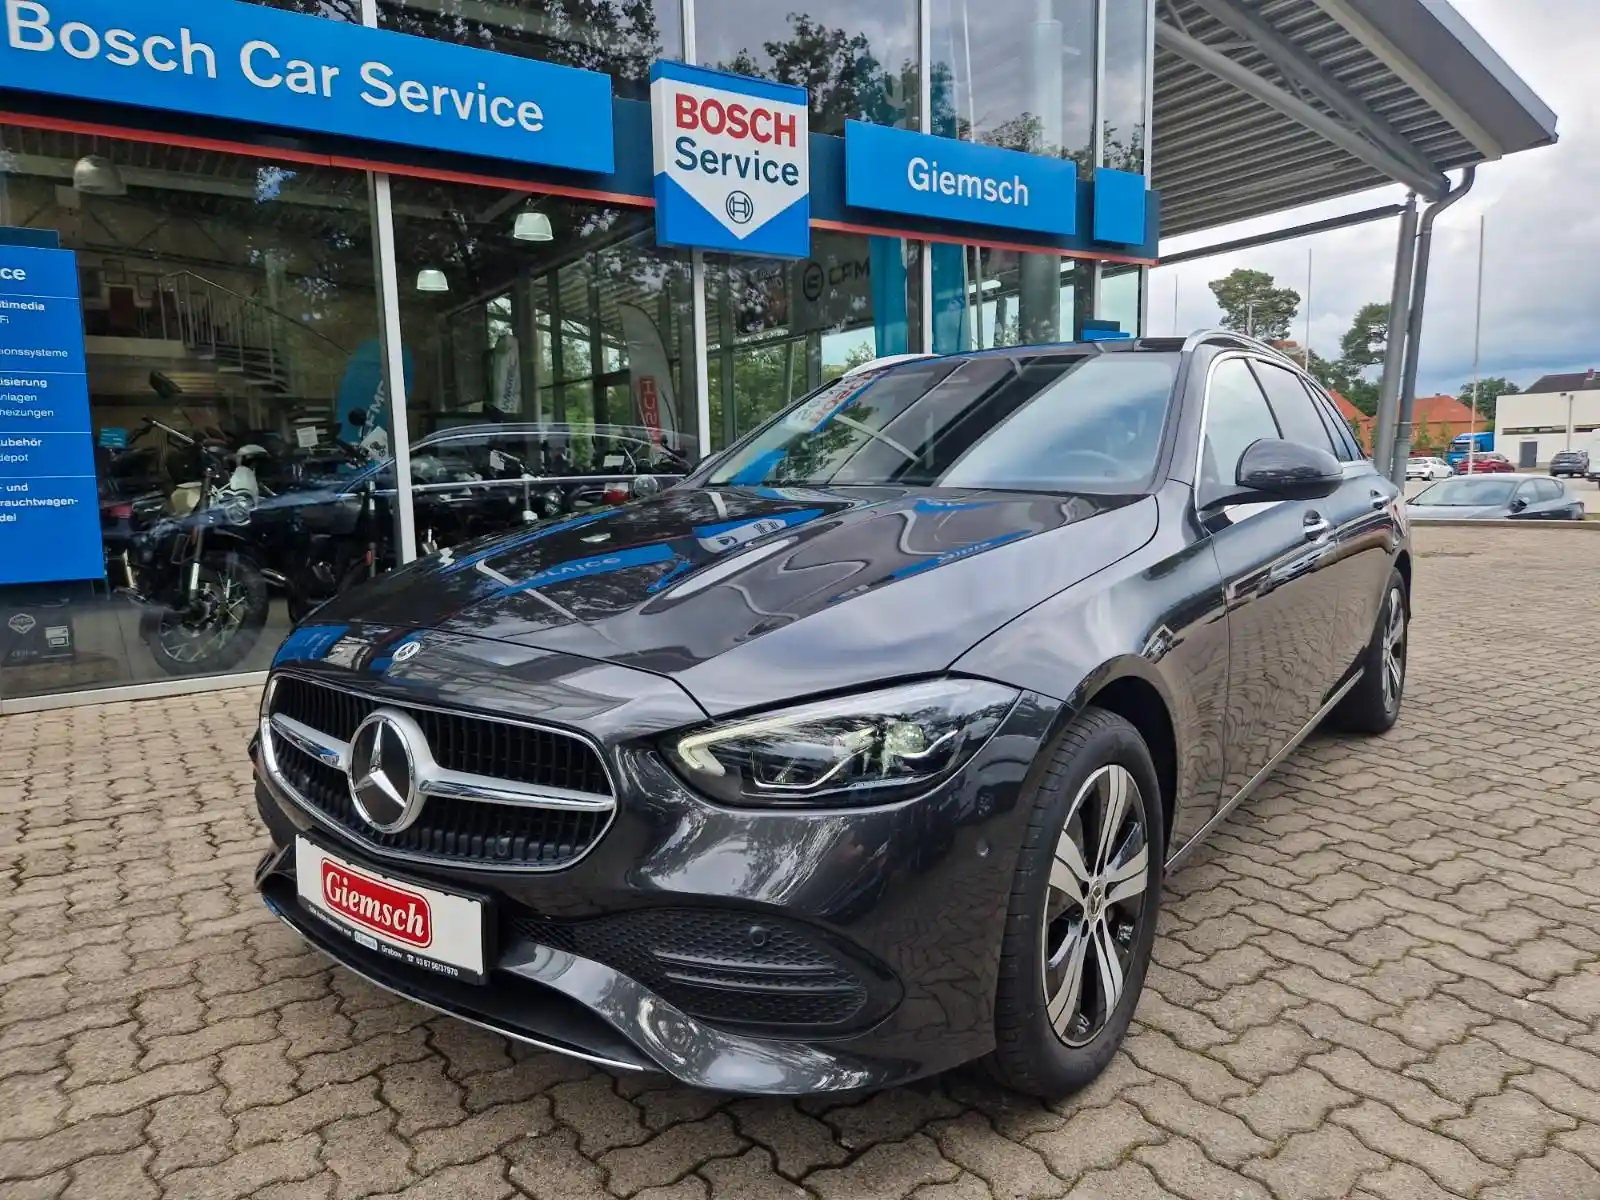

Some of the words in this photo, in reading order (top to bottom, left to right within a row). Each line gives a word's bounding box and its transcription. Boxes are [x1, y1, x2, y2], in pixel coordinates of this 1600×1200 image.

[6, 0, 217, 79] Bosch
[240, 41, 340, 98] Car
[360, 61, 545, 133] Service
[675, 92, 797, 148] BOSCH
[675, 136, 799, 187] Service
[907, 156, 1029, 207] Giemsch
[325, 871, 425, 938] Giemsch
